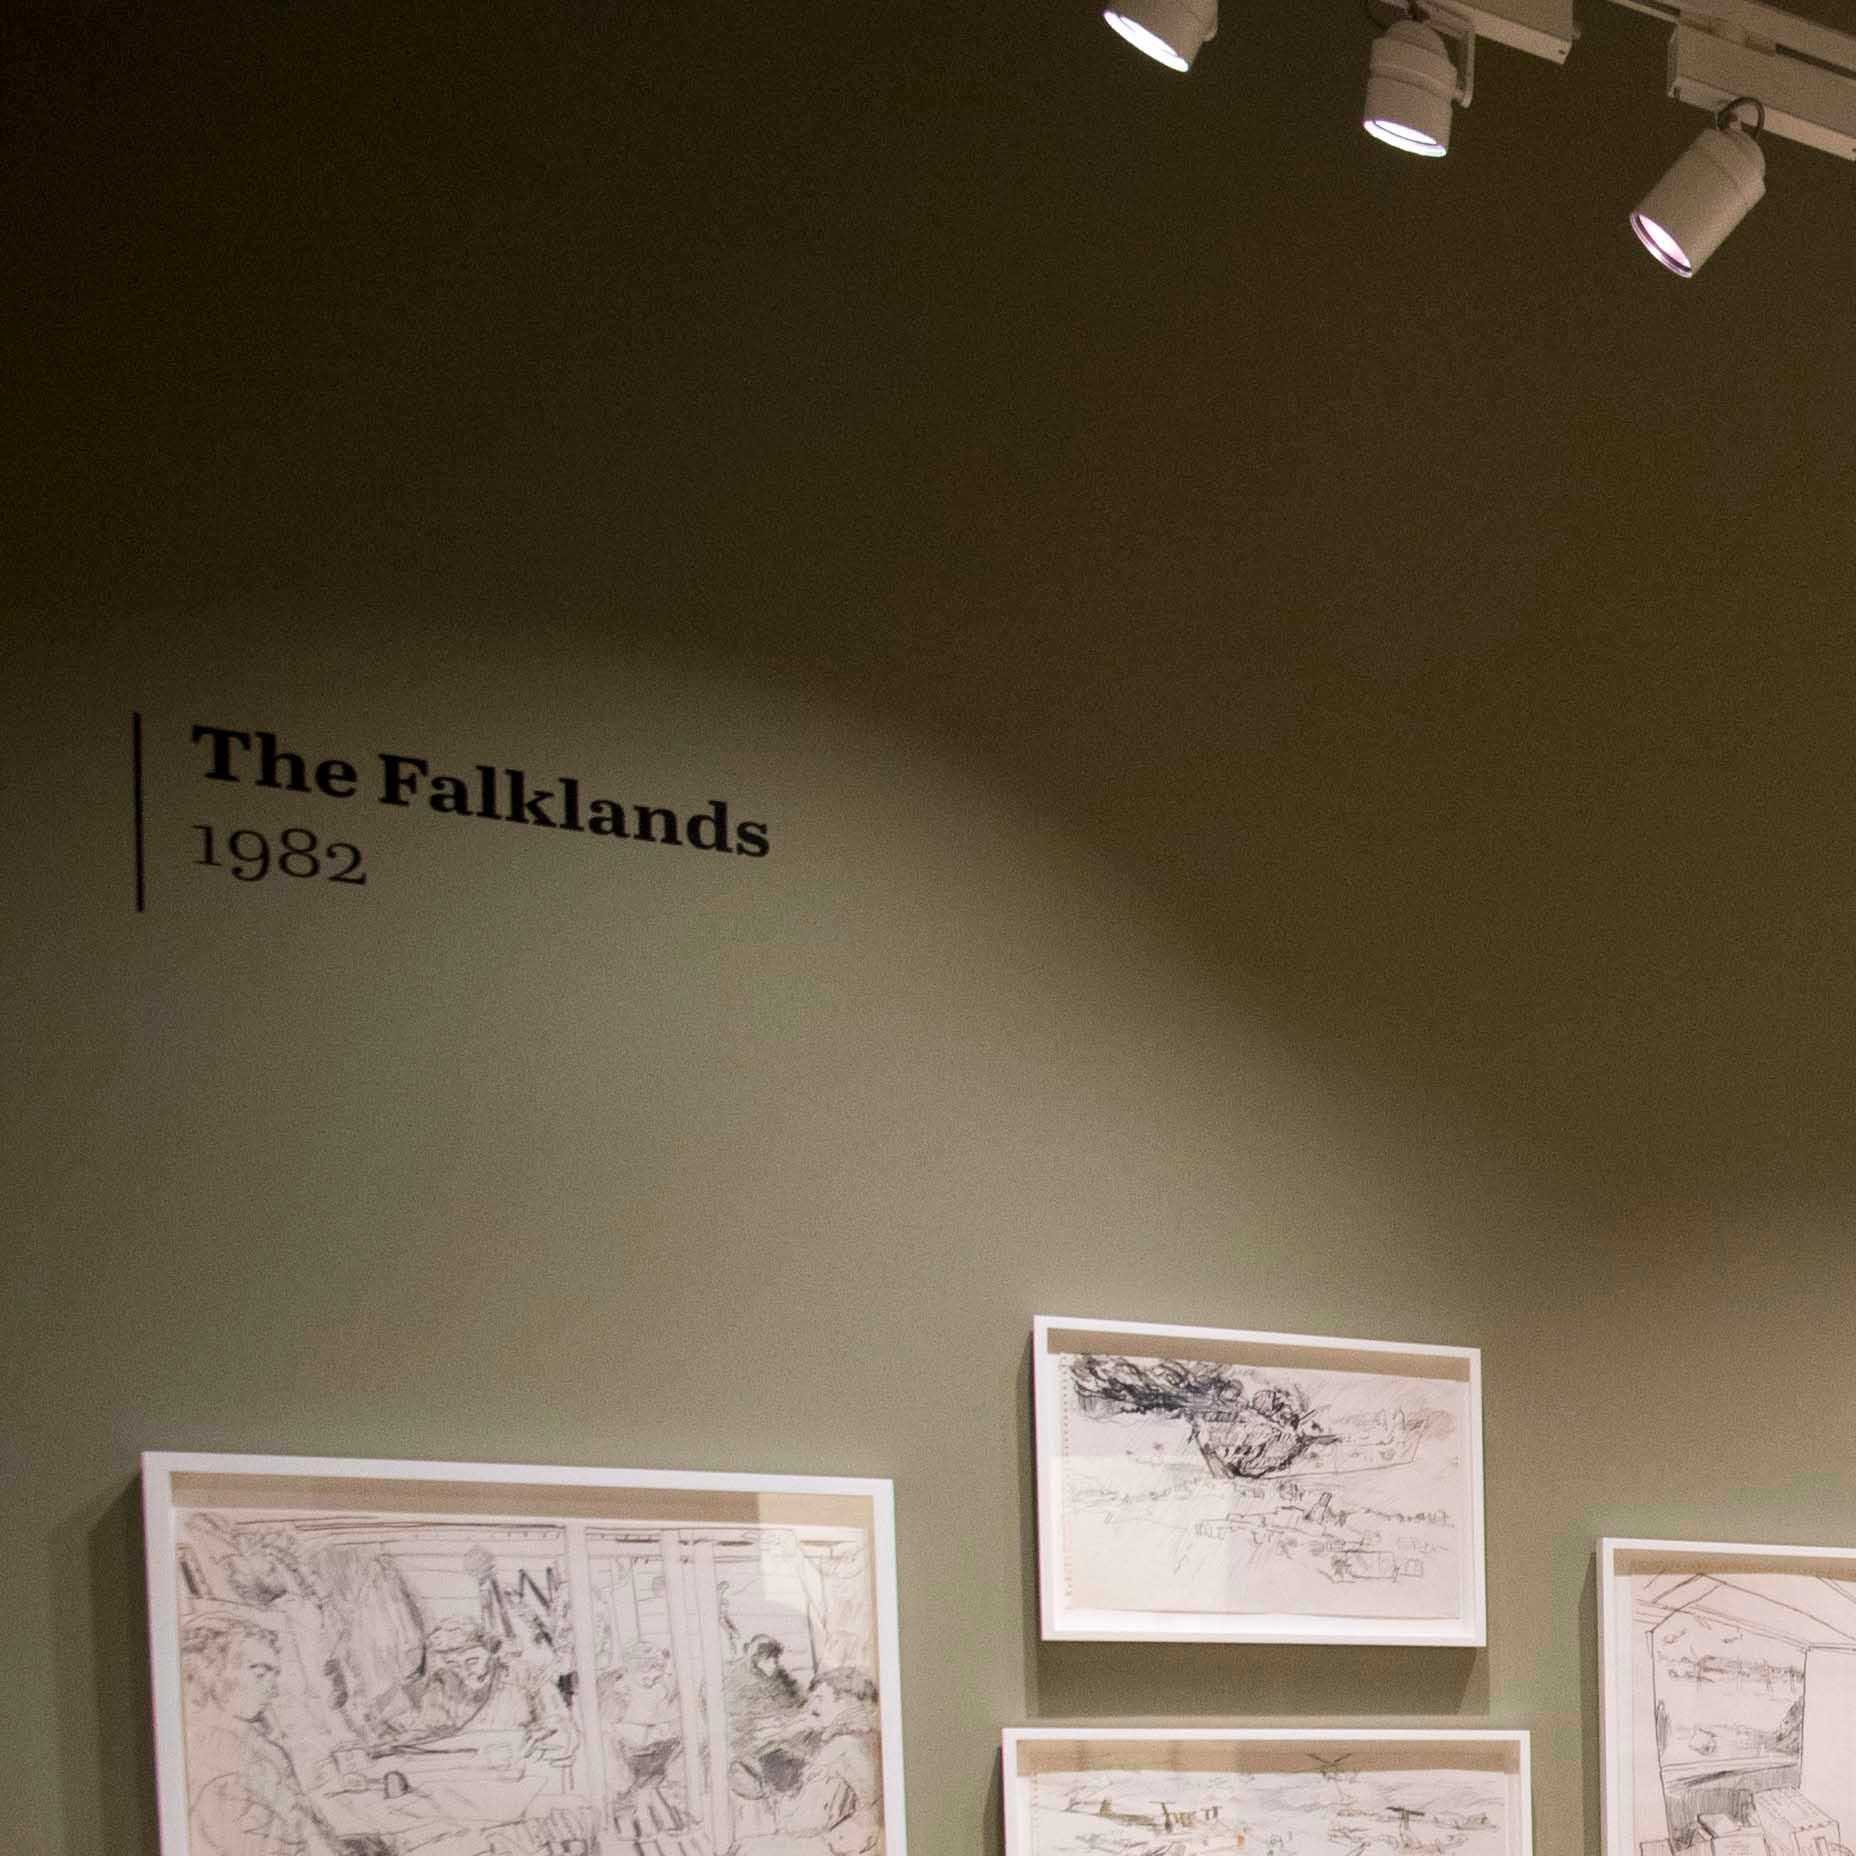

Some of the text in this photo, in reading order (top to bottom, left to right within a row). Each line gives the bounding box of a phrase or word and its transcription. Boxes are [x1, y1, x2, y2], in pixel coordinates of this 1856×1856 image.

[191, 723, 771, 858] The Falklands
[191, 823, 368, 885] 1982
